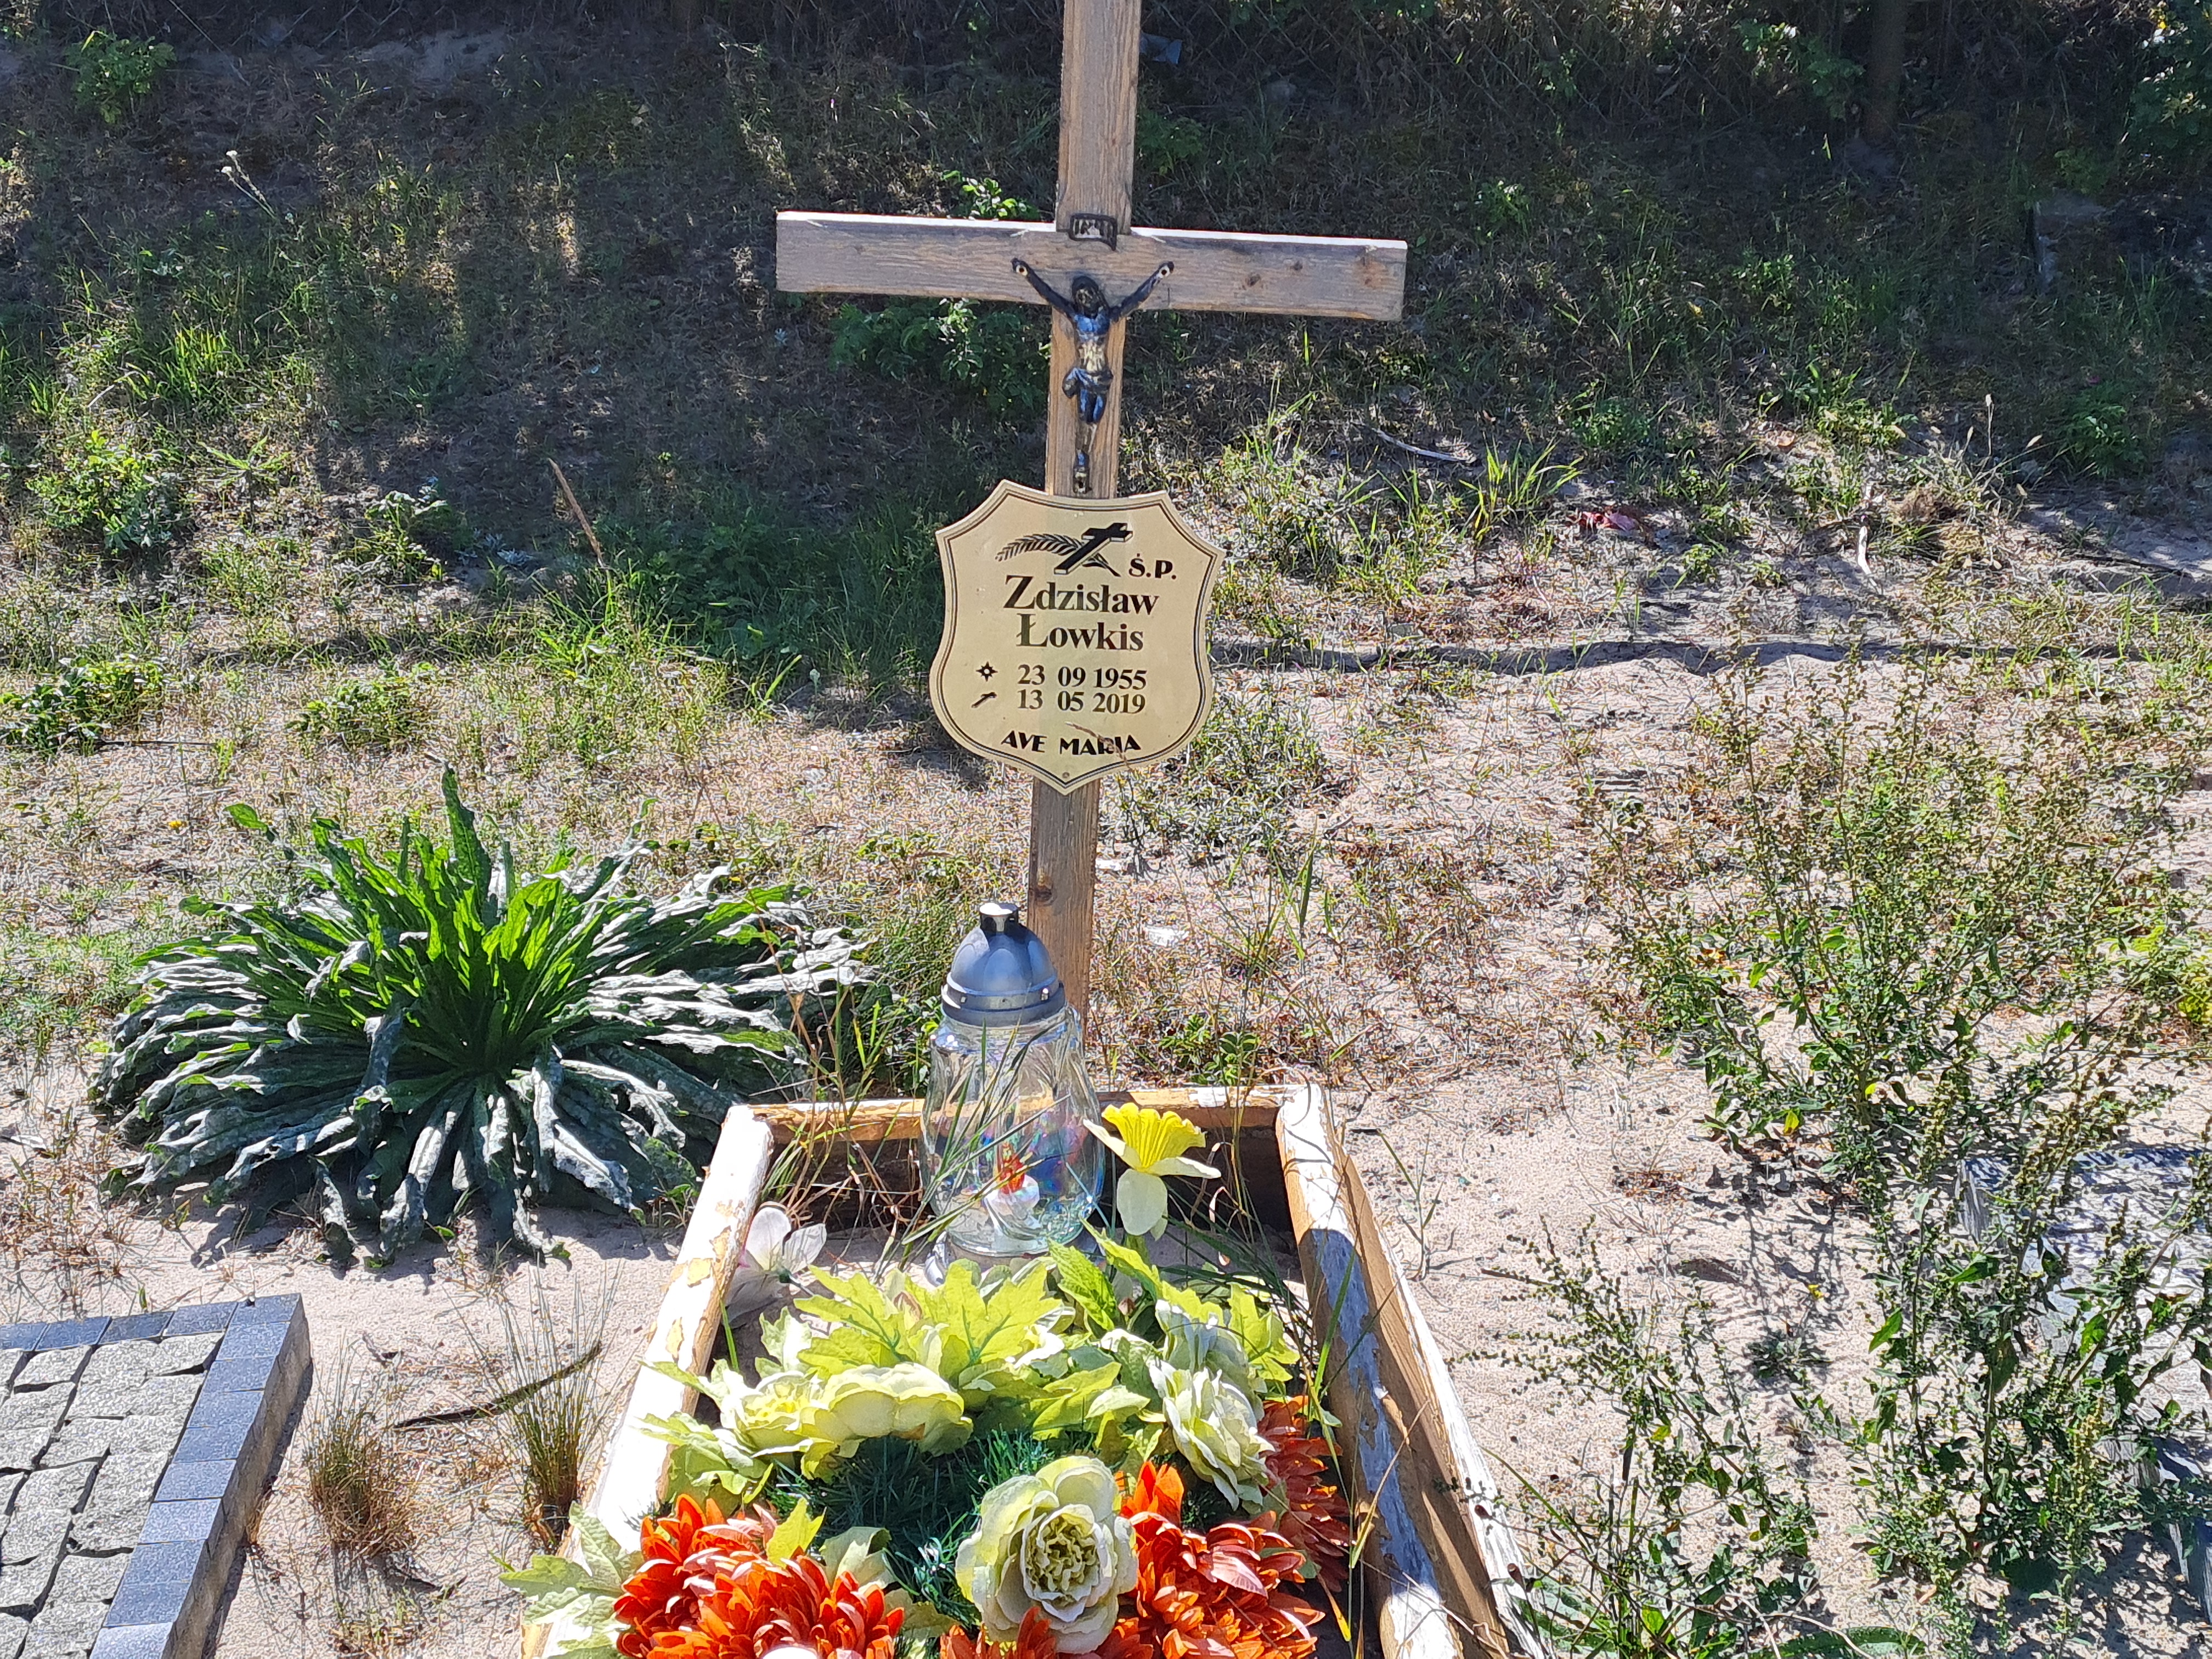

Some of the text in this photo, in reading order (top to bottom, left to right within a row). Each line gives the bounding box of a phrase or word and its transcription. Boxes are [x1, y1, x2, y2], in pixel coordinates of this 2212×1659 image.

[1003, 574, 1160, 616] Zdzisław
[1016, 613, 1144, 651] Łowkis
[1018, 664, 1147, 690] 23 09 1955
[1018, 689, 1146, 714] 13 05 2019
[1001, 730, 1142, 755] AVE MARIA
